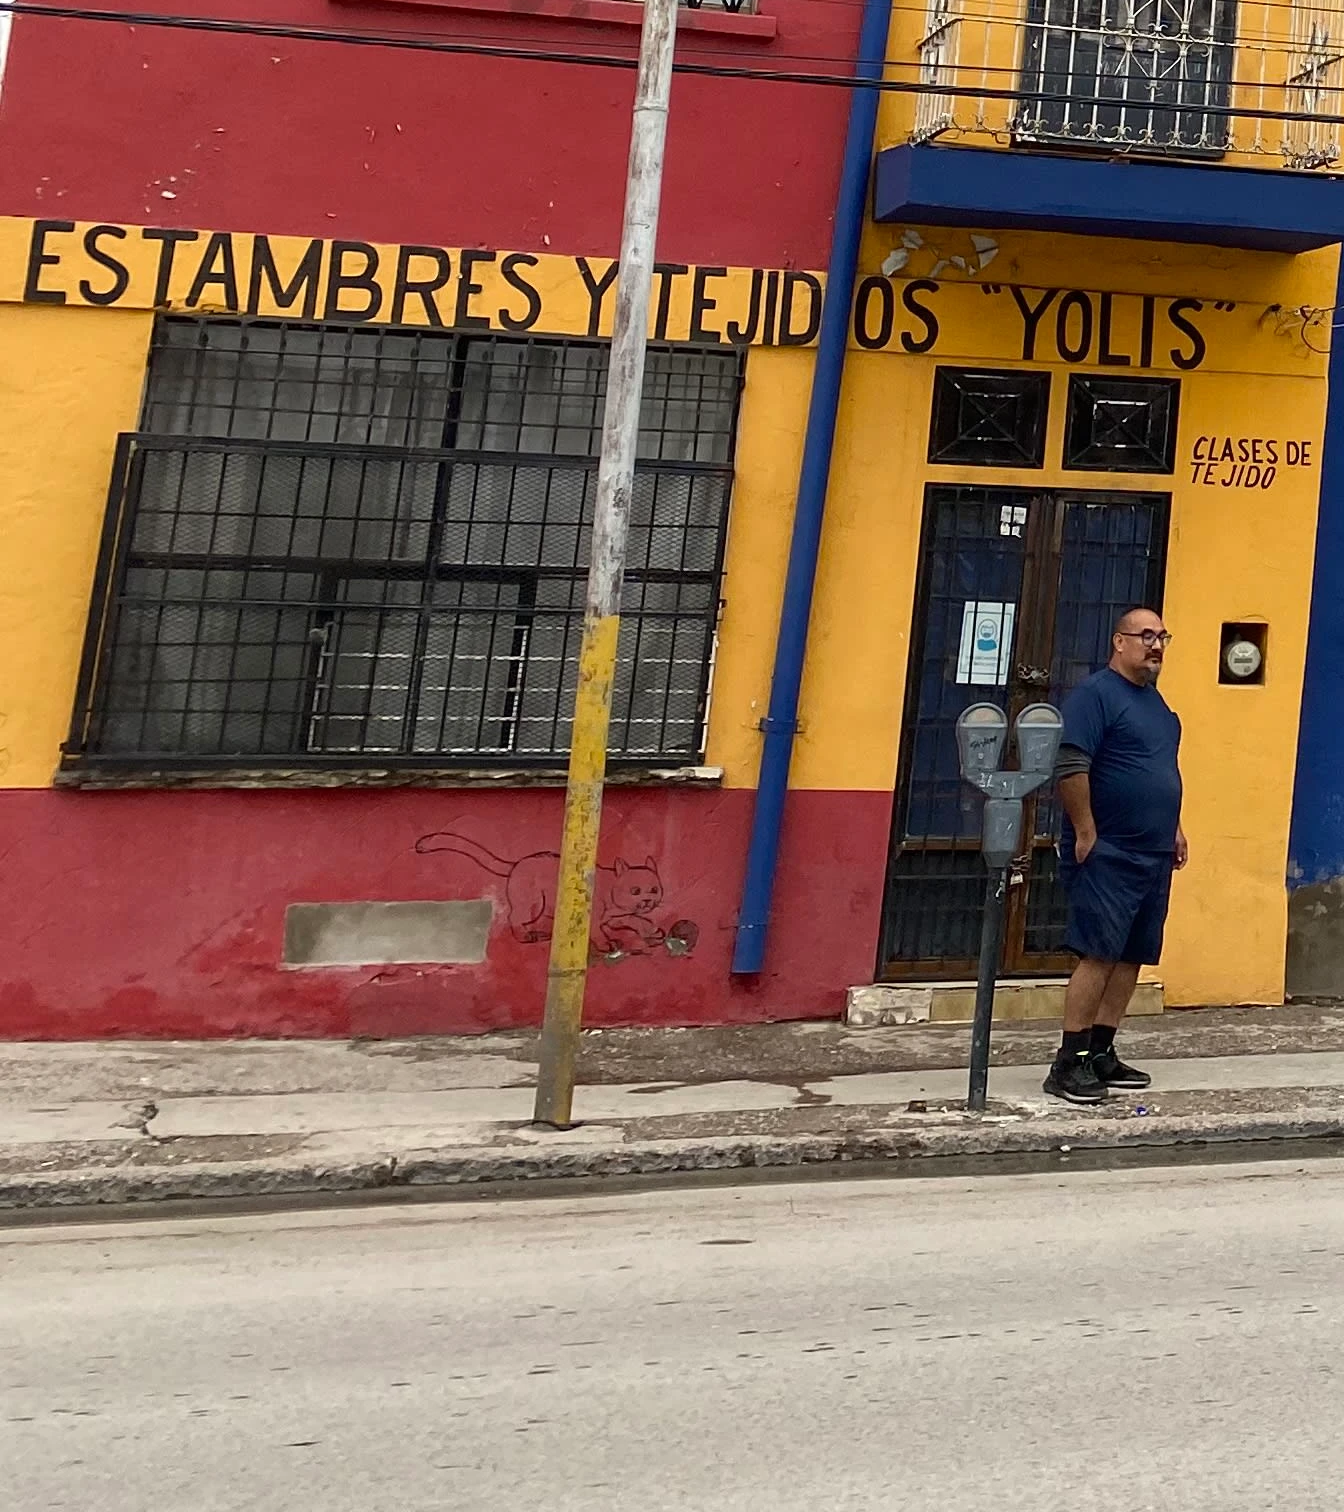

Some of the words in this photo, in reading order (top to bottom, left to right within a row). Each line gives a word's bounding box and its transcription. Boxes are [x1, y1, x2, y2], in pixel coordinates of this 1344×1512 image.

[25, 219, 542, 331] ESTAMBRES
[575, 257, 620, 337] Y
[982, 284, 1236, 370] "YOLIS"
[1193, 436, 1279, 465] CLASES
[1286, 441, 1312, 466] DE
[1190, 461, 1277, 490] TEJIDO
